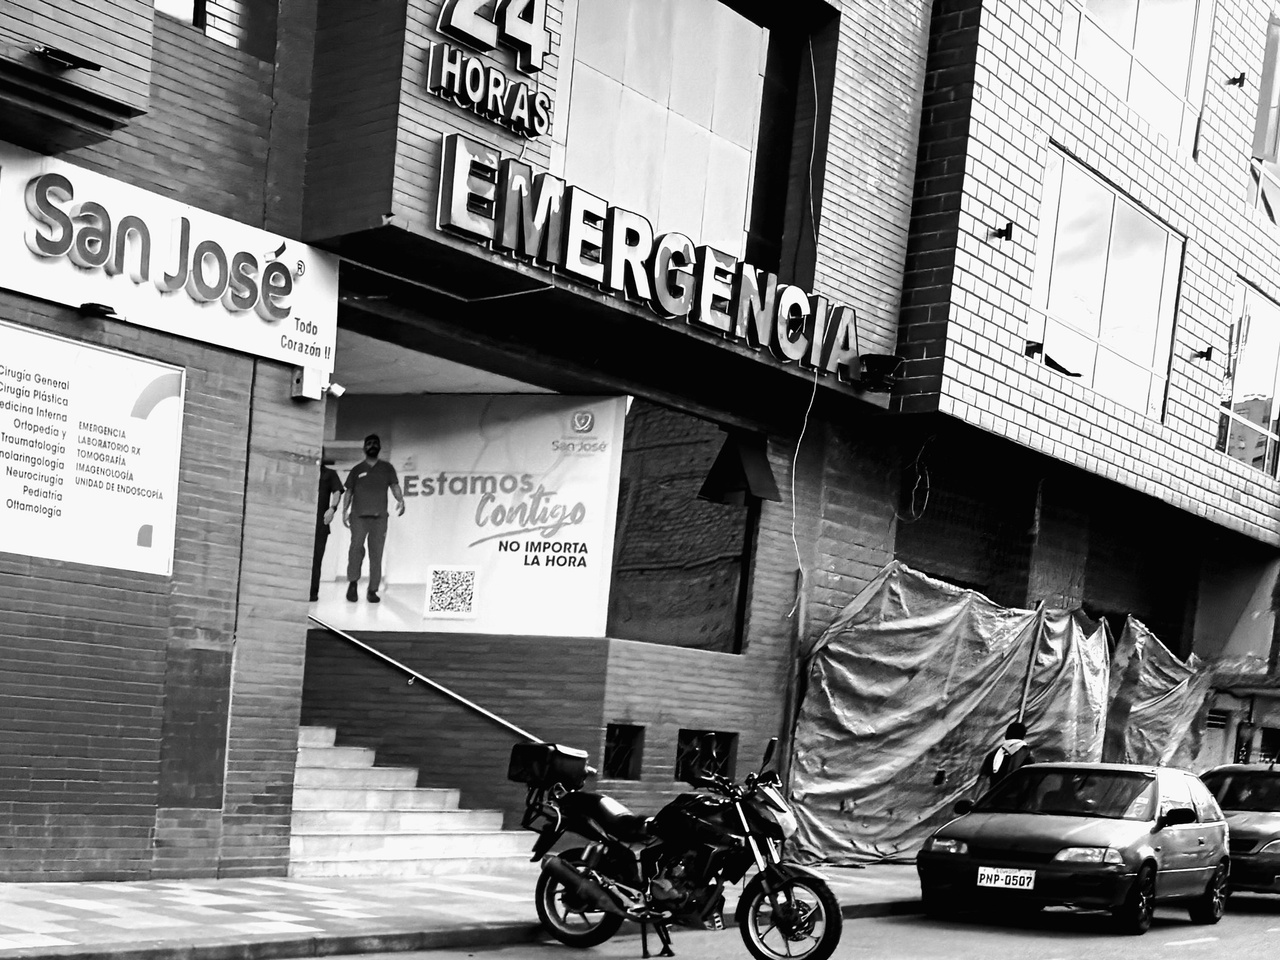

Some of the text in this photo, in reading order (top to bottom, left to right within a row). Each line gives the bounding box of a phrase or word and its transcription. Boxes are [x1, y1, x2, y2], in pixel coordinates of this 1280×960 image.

[427, 41, 551, 140] HORAS
[24, 173, 151, 284] San
[156, 217, 294, 323] José
[436, 131, 861, 383] EMERGENCIA
[294, 317, 318, 336] Todo
[280, 334, 321, 358] Corazón
[34, 373, 70, 390] General
[33, 389, 69, 406] Plástica
[36, 406, 68, 422] Interna
[78, 421, 126, 439] EMERGENCIA
[0, 431, 65, 455] Traumatología
[77, 435, 129, 454] LABORATORIO
[6, 465, 64, 487] Neurocirugía
[75, 476, 103, 489] UNIDAD
[105, 482, 115, 491] DE
[403, 471, 533, 497] Estamos
[22, 485, 63, 501] Pediatría
[474, 483, 586, 539] Contigo
[498, 540, 588, 554] NO IMPORTA
[523, 555, 587, 568] LA HORA
[978, 873, 1033, 887] PNP-0507
